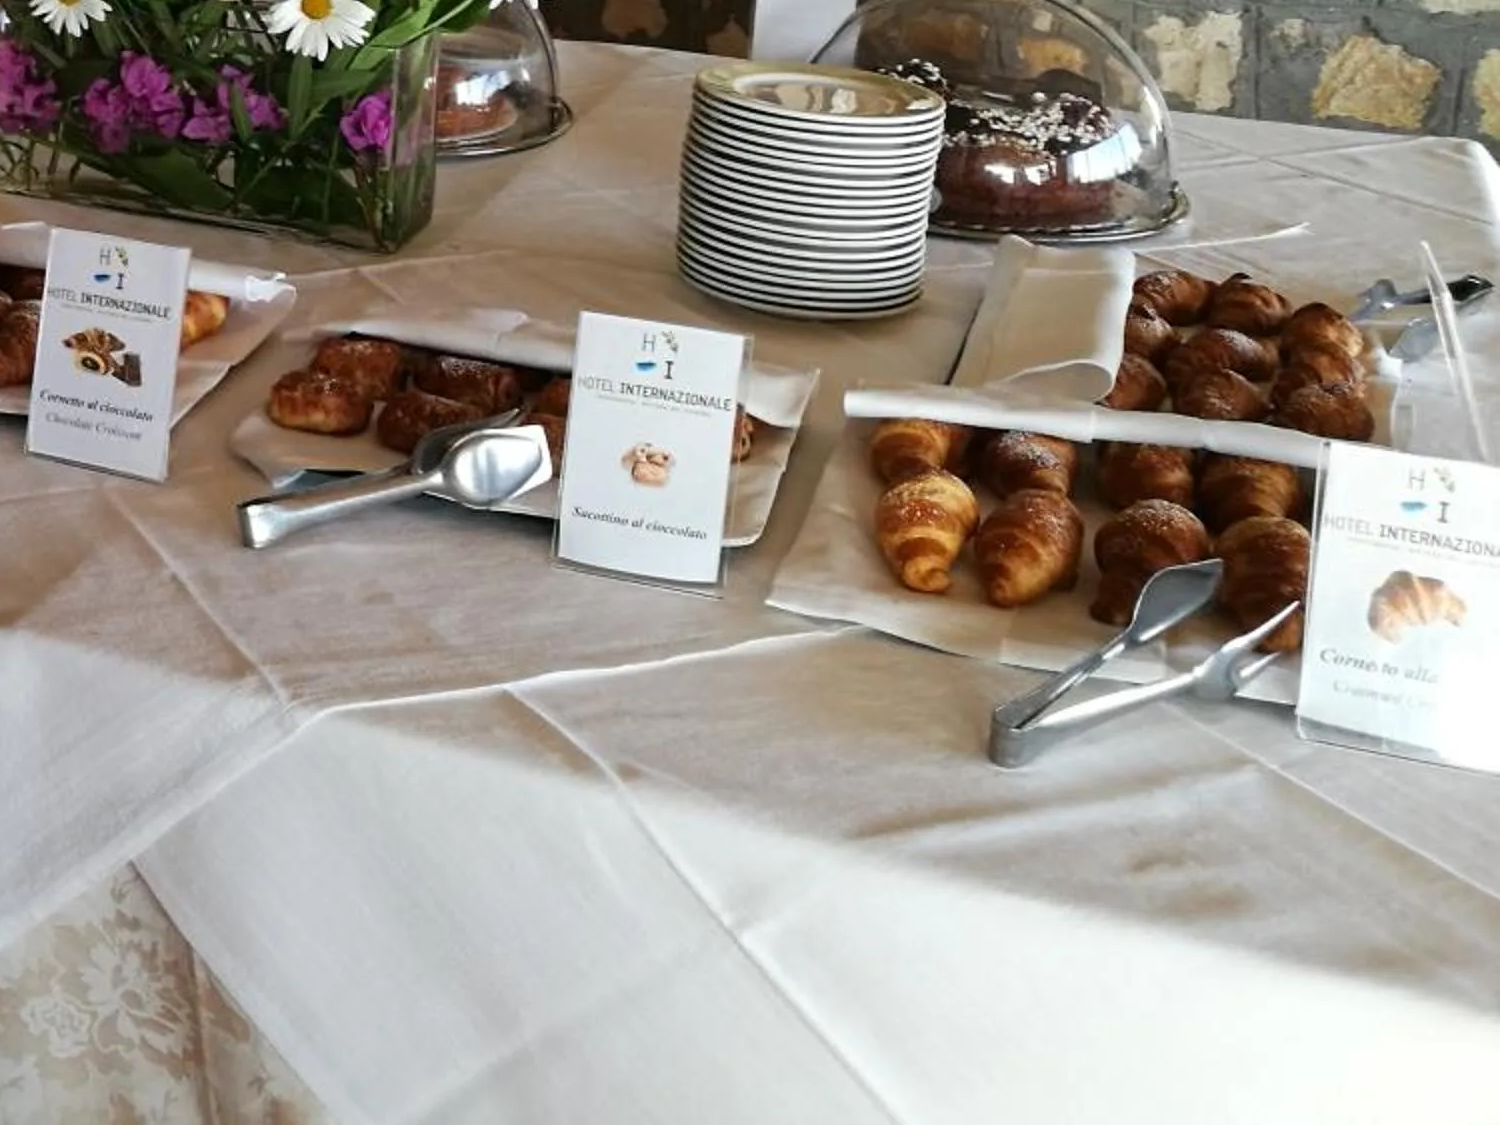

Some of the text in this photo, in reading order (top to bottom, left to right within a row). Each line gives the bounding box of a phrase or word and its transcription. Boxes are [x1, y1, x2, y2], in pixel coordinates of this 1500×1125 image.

[48, 286, 77, 302] HOTEL
[80, 292, 171, 319] INTERNAZIONALE
[577, 375, 614, 393] HOTEL
[619, 381, 733, 412] INTERNAZIONALE
[645, 520, 707, 540] cioccolato
[1322, 513, 1375, 536] HOTEL
[1319, 647, 1399, 676] Corneto
